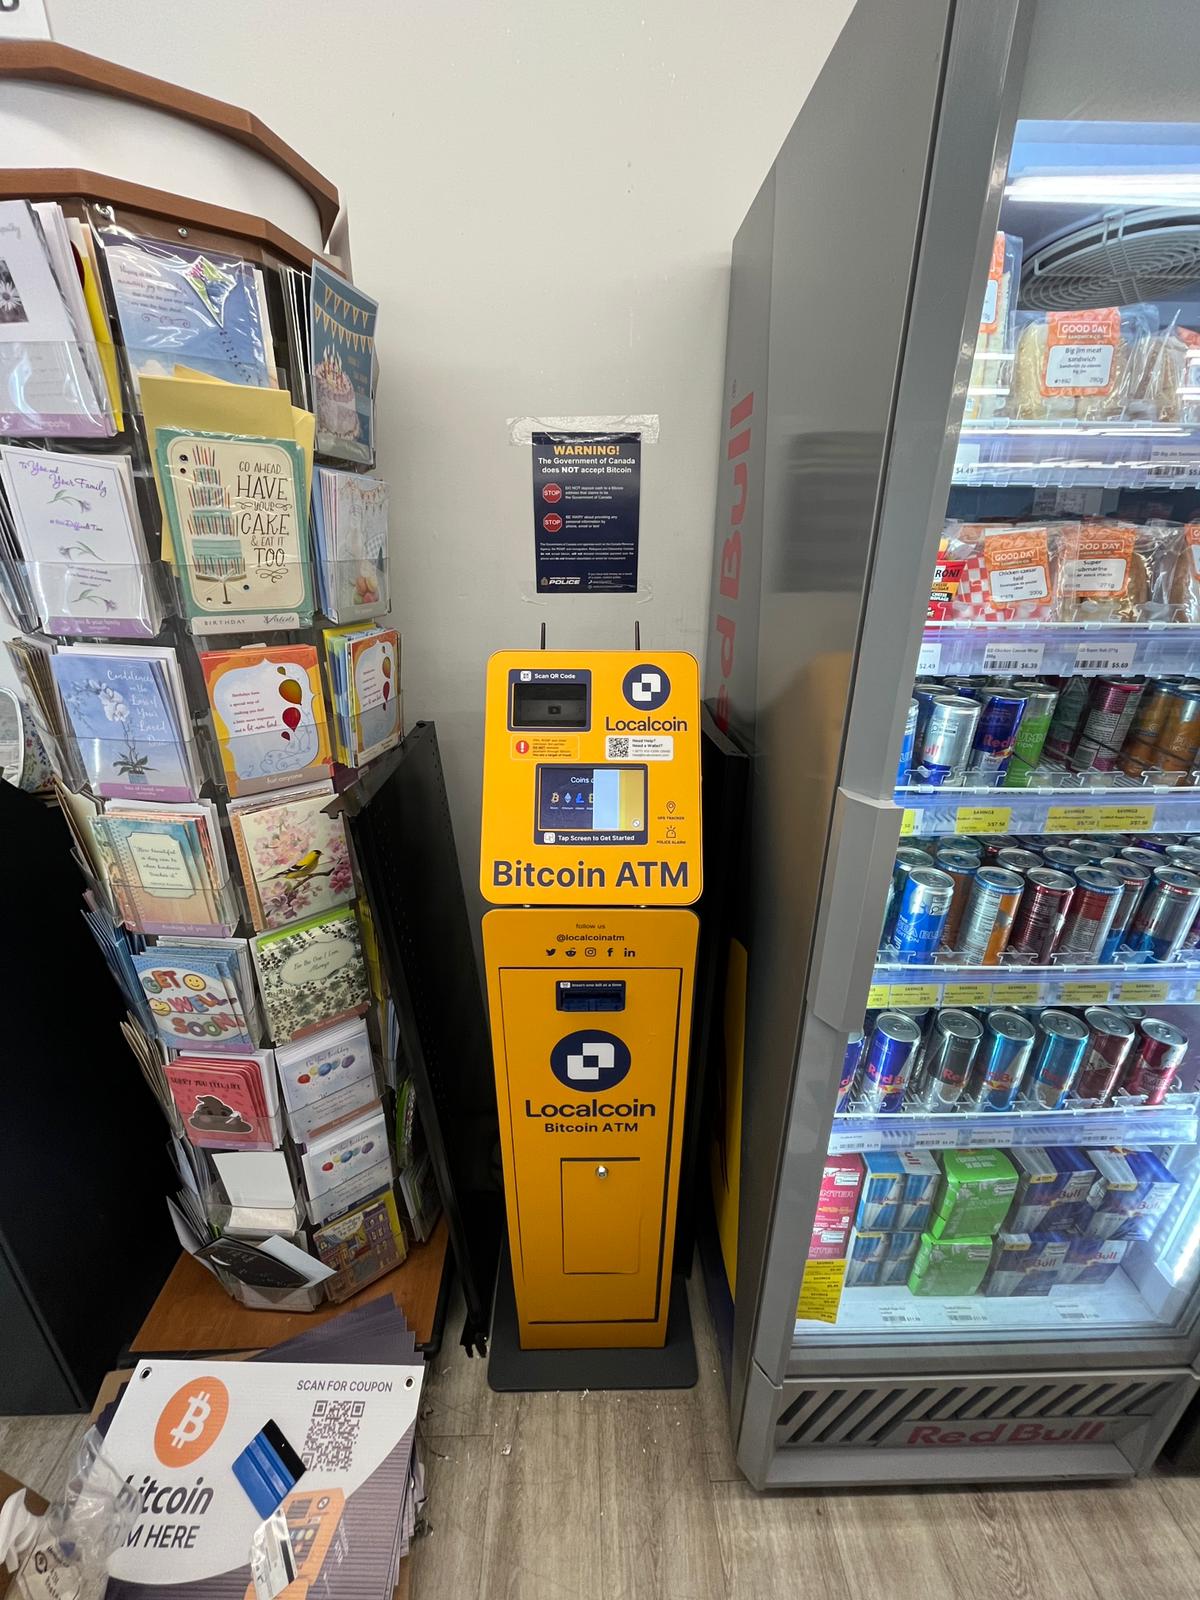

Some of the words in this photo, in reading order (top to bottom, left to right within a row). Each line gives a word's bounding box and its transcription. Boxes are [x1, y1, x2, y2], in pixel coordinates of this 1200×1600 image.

[1062, 324, 1090, 333] GOOD
[1092, 324, 1108, 333] DAY
[553, 445, 620, 455] WARNING!
[239, 461, 250, 472] GO
[538, 457, 551, 465] The
[553, 457, 598, 465] Government
[600, 457, 607, 465] of
[608, 457, 636, 465] Canada
[541, 466, 560, 474] does
[561, 466, 579, 474] NOT
[580, 467, 605, 475] accept
[606, 466, 632, 474] Bitcoin
[75, 477, 107, 498] Family
[236, 475, 288, 500] HAVE
[254, 502, 274, 512] YOUR
[241, 512, 290, 536] CAKE
[250, 536, 259, 546] &
[261, 536, 274, 546] EAT
[278, 536, 284, 546] IT
[1102, 542, 1120, 550] DAY
[995, 552, 1018, 560] GOOD
[1020, 550, 1036, 559] DAY
[204, 618, 246, 626] BIRTHDAY
[606, 716, 688, 732] Localcoin
[570, 776, 590, 784] Coins
[494, 860, 605, 888] Bitcoin
[615, 862, 688, 888] ATM
[556, 934, 624, 942] @localcoinatm
[142, 970, 181, 994] GET
[166, 992, 229, 1013] WELL
[172, 1012, 237, 1036] SOON
[526, 1098, 656, 1118] Localcoin
[544, 1122, 598, 1133] Bitcoin
[602, 1122, 638, 1133] ATM
[1059, 1189, 1082, 1199] Bull
[296, 1380, 324, 1391] SCAN
[327, 1380, 350, 1392] FOR
[351, 1380, 392, 1393] COUPON
[906, 1422, 1000, 1446] Red
[1007, 1421, 1104, 1444] Bull
[144, 1524, 200, 1548] HERE
